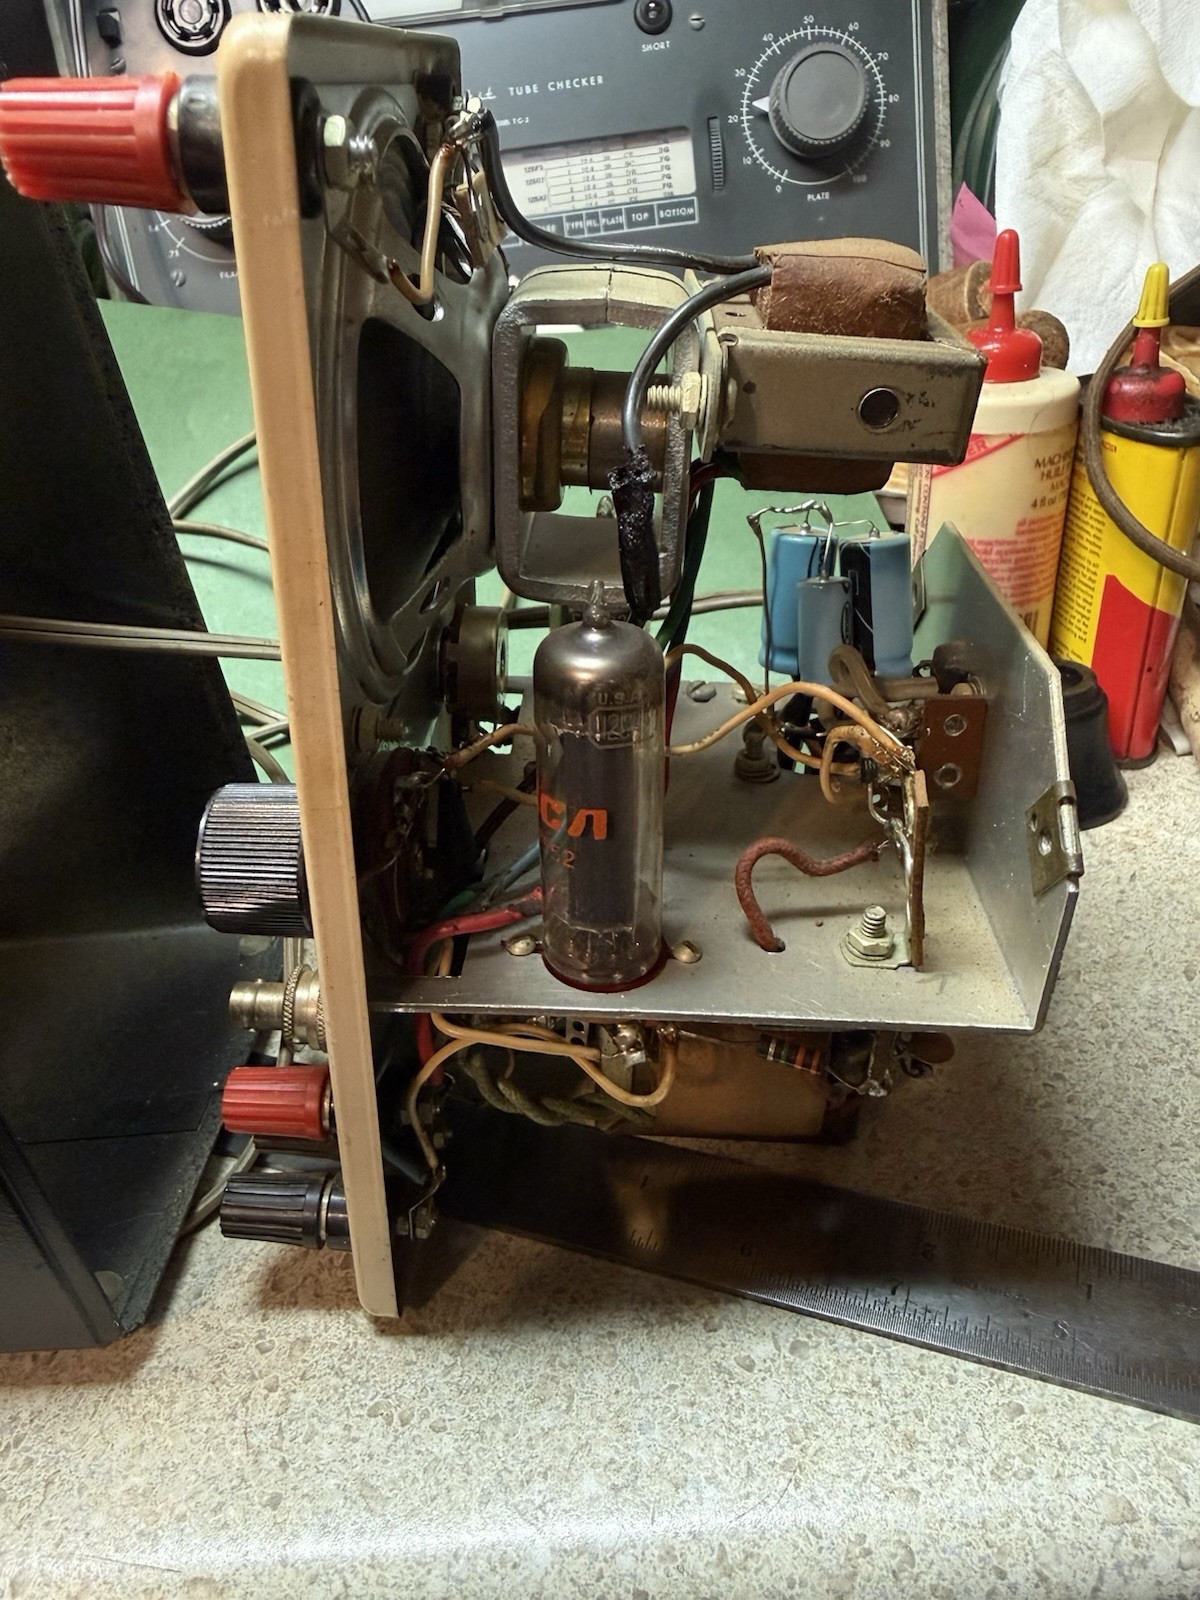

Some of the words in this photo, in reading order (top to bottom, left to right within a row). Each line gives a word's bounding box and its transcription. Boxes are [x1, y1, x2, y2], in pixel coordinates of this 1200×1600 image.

[803, 14, 815, 23] 50
[848, 21, 860, 30] 60
[761, 32, 775, 42] 40
[641, 40, 671, 53] SHORT
[876, 51, 890, 60] 70
[734, 68, 746, 77] 30
[508, 83, 539, 97] TUBE
[547, 75, 604, 92] CHECKER
[888, 93, 900, 102] 80
[727, 114, 739, 123] 20
[742, 157, 753, 165] 10
[807, 191, 830, 202] PLATE
[631, 211, 649, 223] TOP
[659, 206, 695, 219] BOTTOM
[601, 214, 624, 228] PLATE
